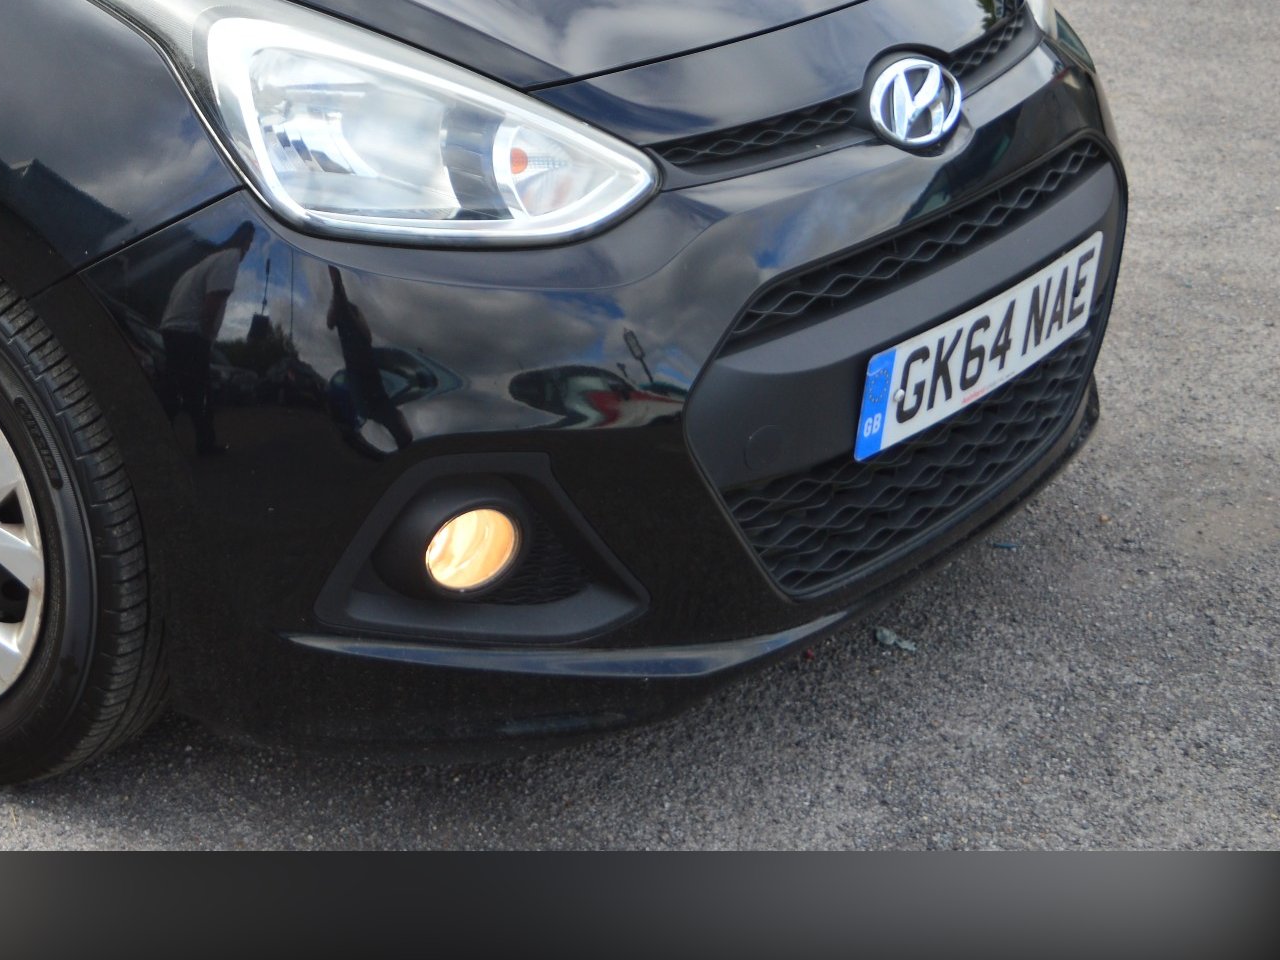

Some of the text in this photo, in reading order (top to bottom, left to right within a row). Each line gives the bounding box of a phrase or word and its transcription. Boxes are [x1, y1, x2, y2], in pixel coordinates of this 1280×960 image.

[895, 246, 1096, 424] GK64 NAE
[863, 412, 882, 438] GB
